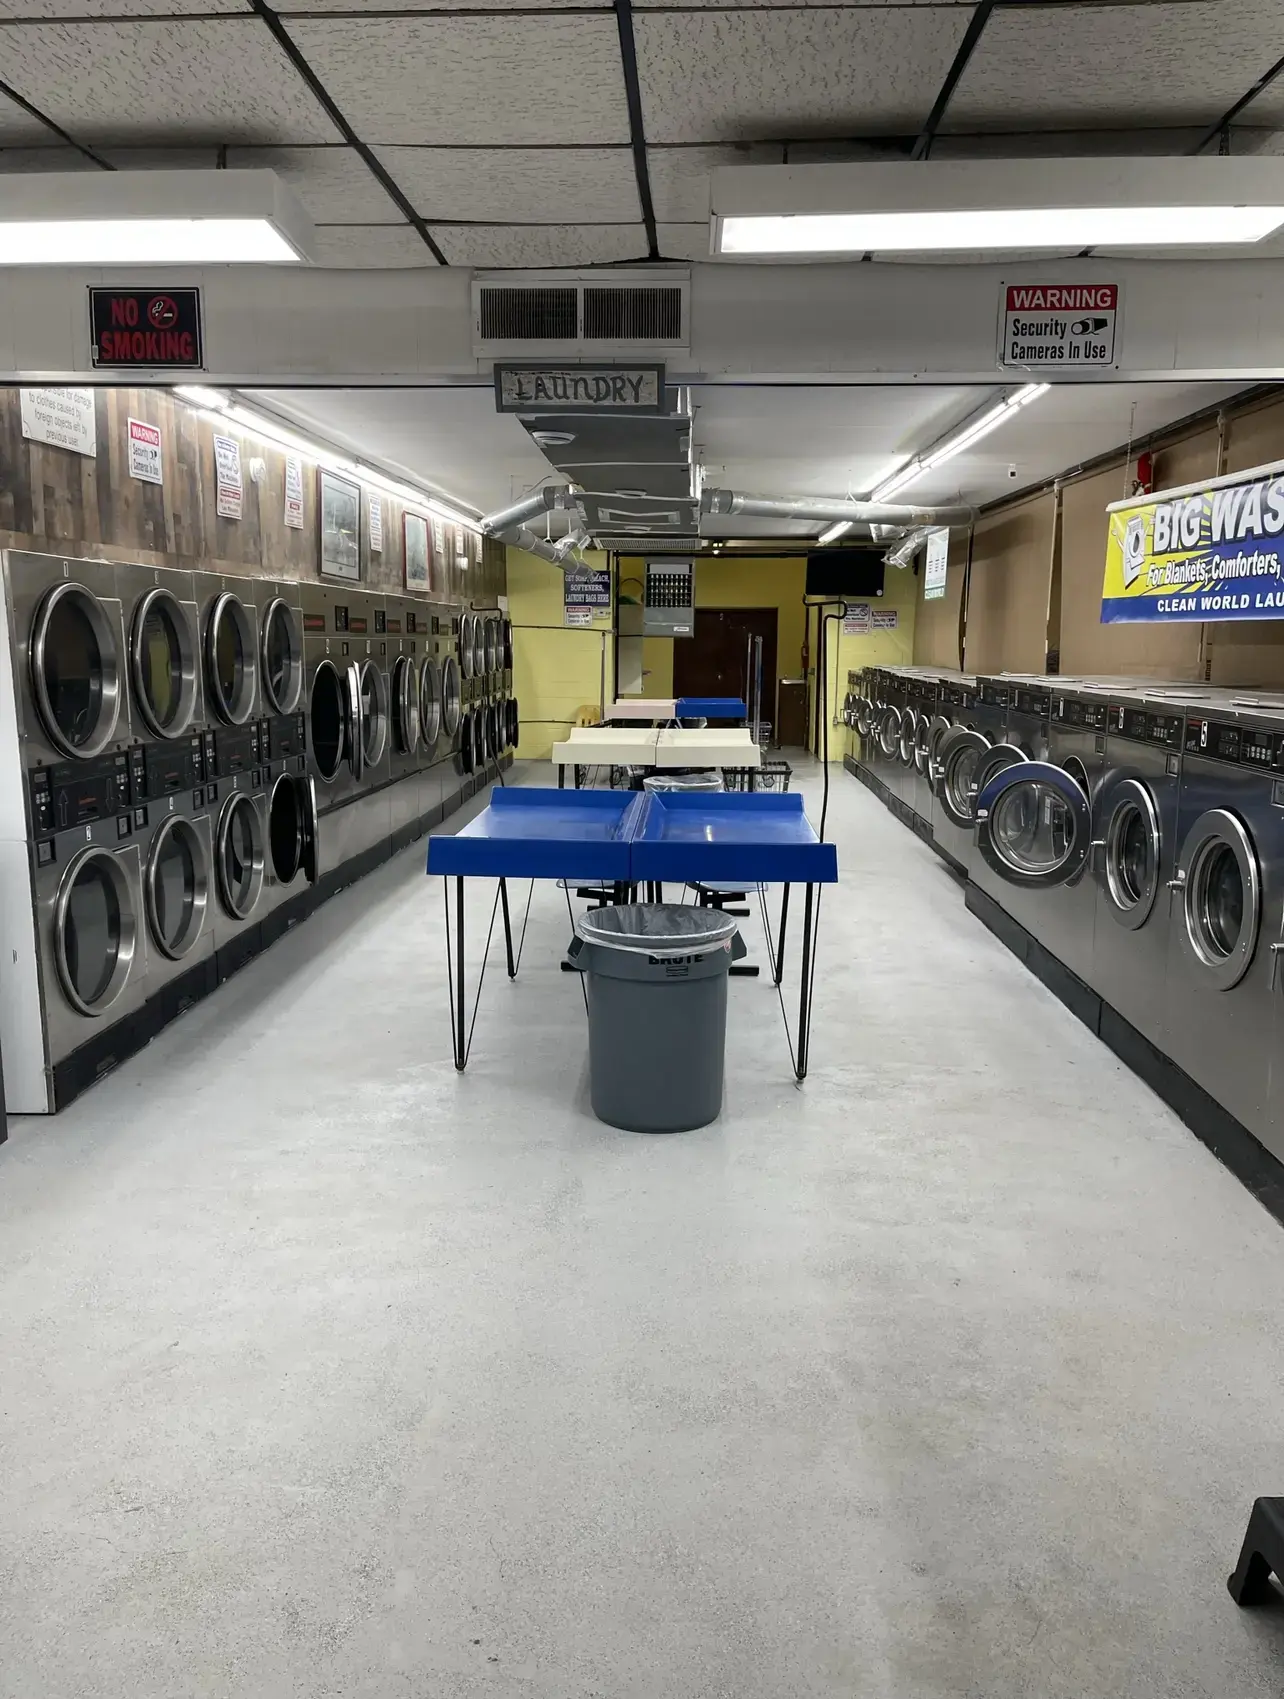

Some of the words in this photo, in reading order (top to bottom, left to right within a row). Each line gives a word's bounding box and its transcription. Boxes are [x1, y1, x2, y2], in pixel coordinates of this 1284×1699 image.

[1013, 288, 1112, 308] WARNING
[111, 298, 139, 326] NO
[1012, 318, 1067, 340] Security
[101, 331, 192, 360] SMOKING
[1012, 341, 1064, 360] Cameras
[1068, 341, 1080, 358] In
[1084, 340, 1106, 359] Use
[514, 374, 644, 403] LAUNDRY
[132, 424, 158, 445] WARNING
[132, 443, 148, 460] Security
[133, 458, 149, 474] Cameras
[1153, 498, 1203, 554] BIG
[1145, 563, 1164, 588] For
[1165, 557, 1210, 584] Blankets,
[1212, 548, 1282, 580] Comforters,
[565, 594, 584, 602] LAUNDRY
[586, 594, 596, 602] BAGS
[1157, 597, 1197, 612] CLEAN
[1201, 594, 1250, 610] WORLD
